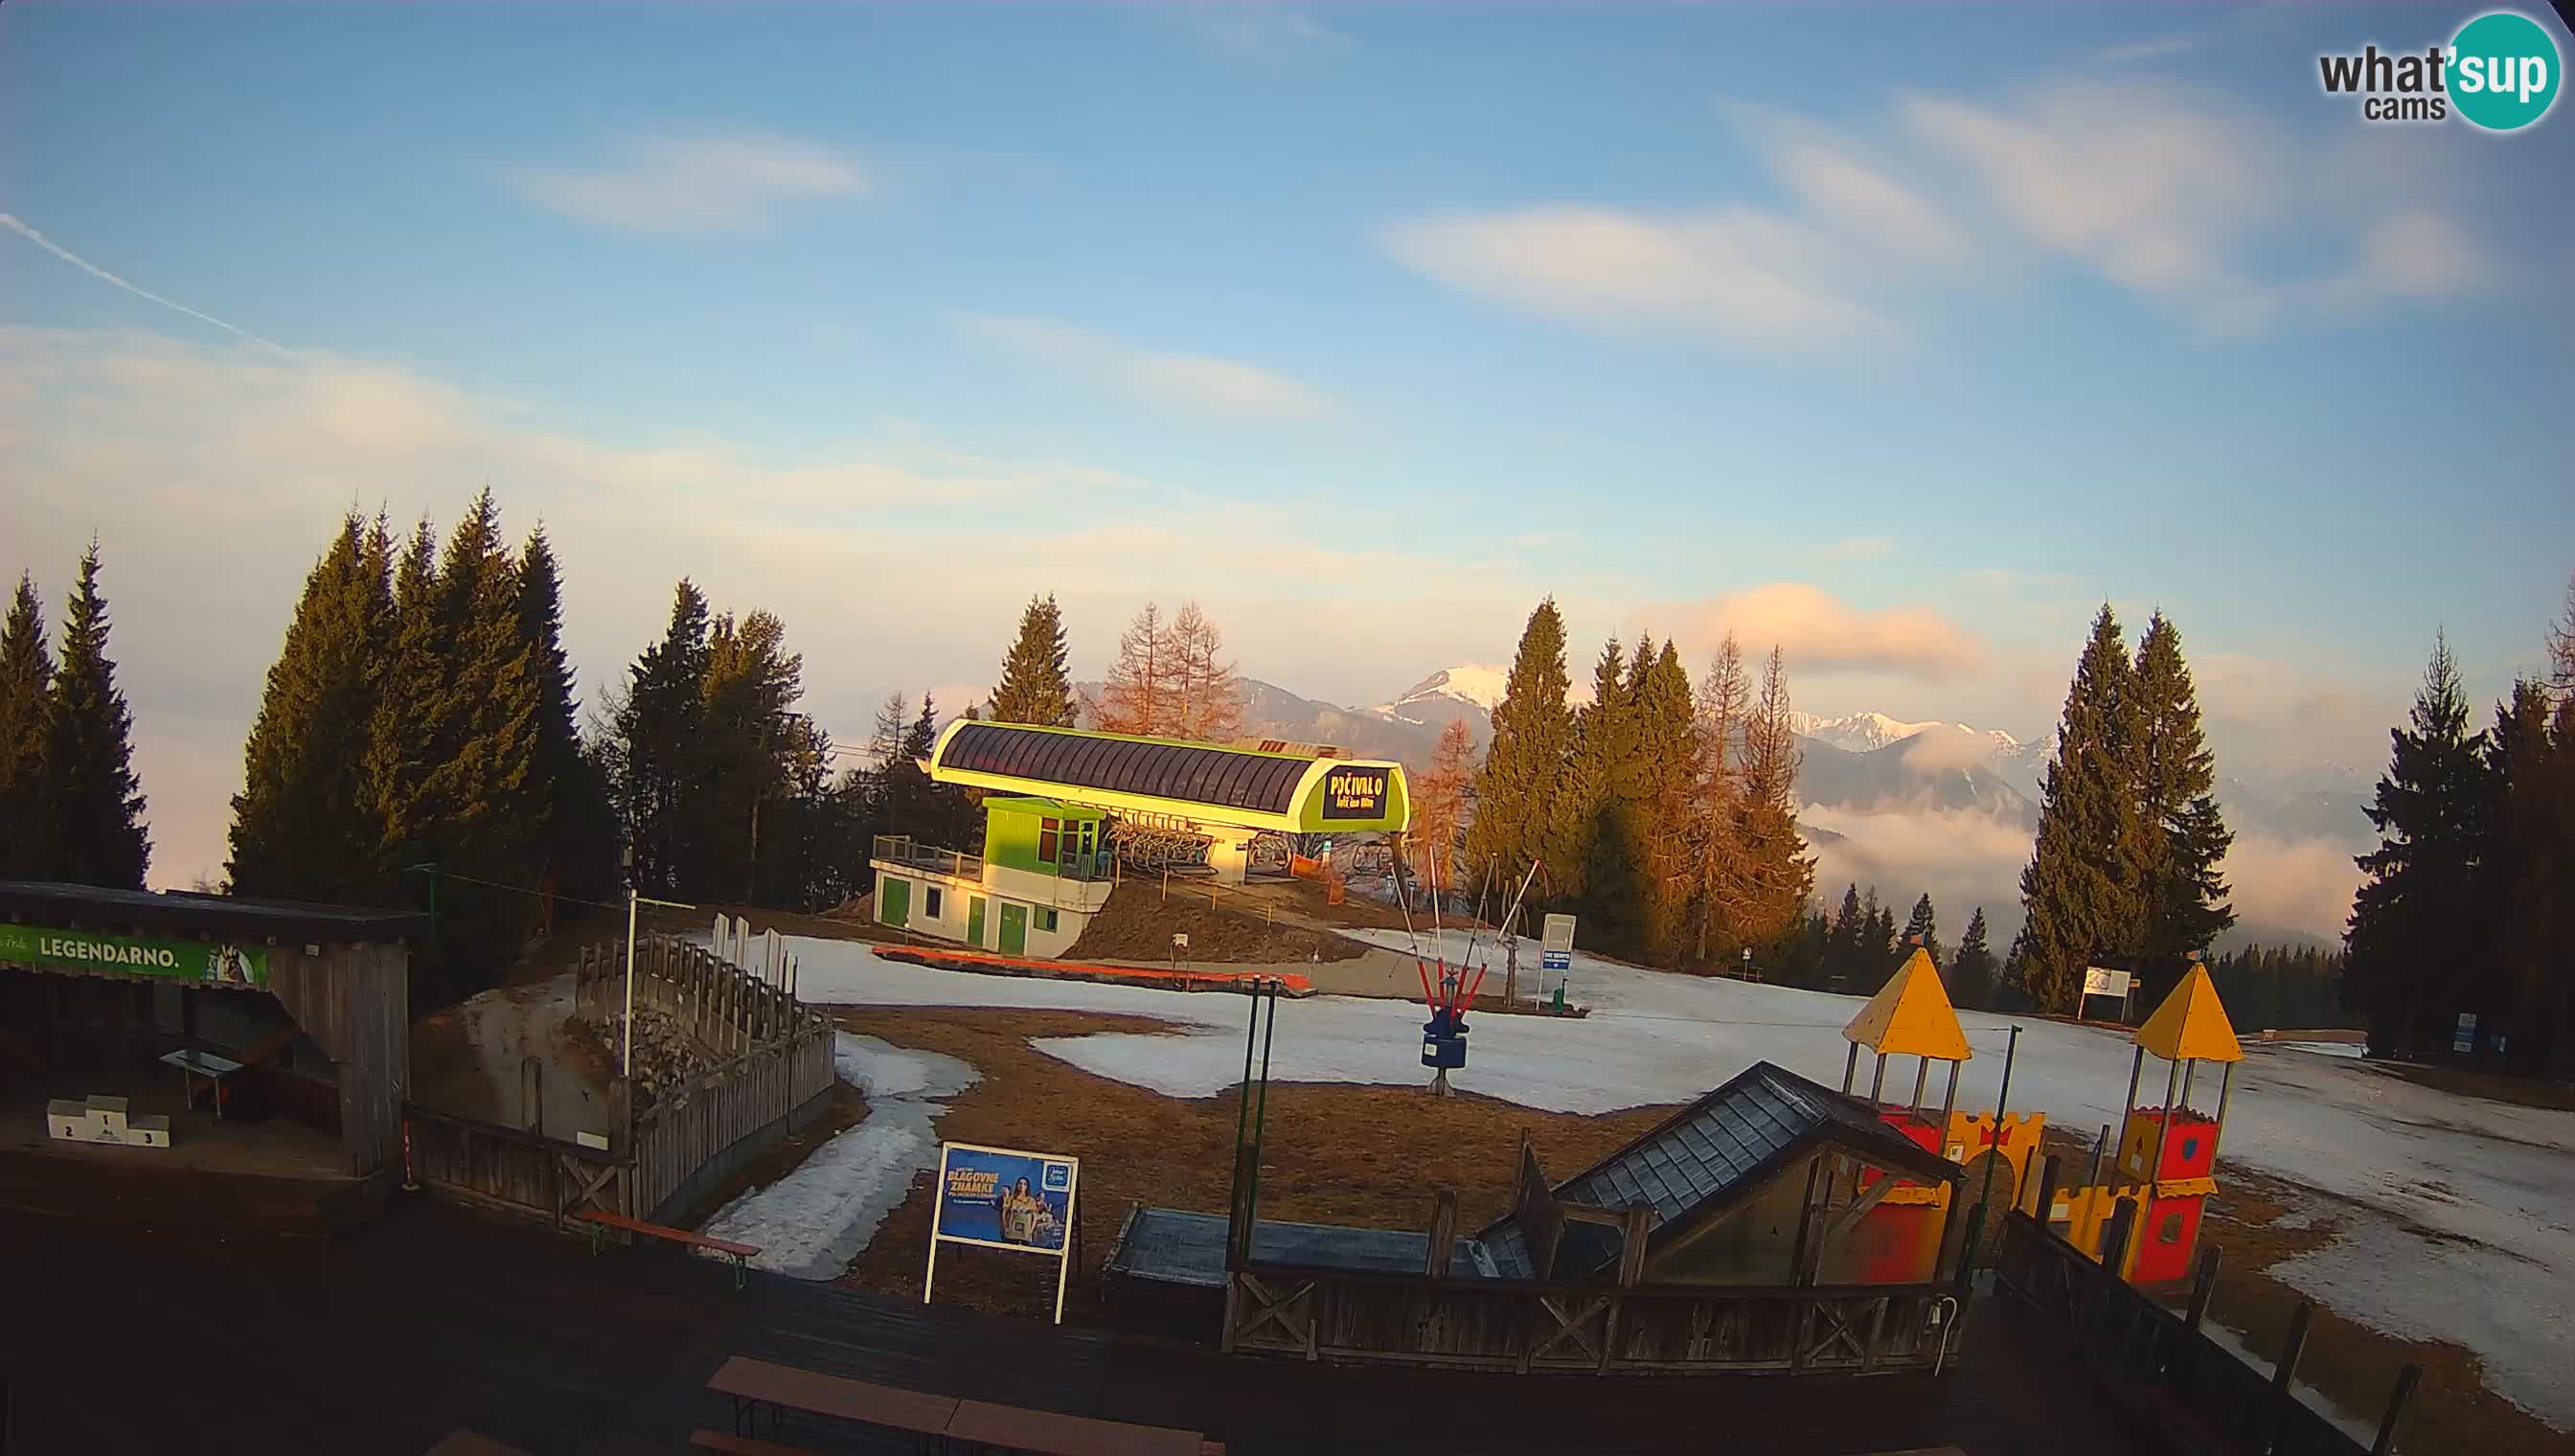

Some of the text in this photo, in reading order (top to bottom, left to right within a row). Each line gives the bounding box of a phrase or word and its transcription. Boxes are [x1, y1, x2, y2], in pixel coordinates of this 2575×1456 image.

[39, 936, 180, 969] LEGENDARNO.
[103, 1114, 109, 1125] 1
[65, 1125, 75, 1137] 2
[145, 1132, 153, 1145] 3
